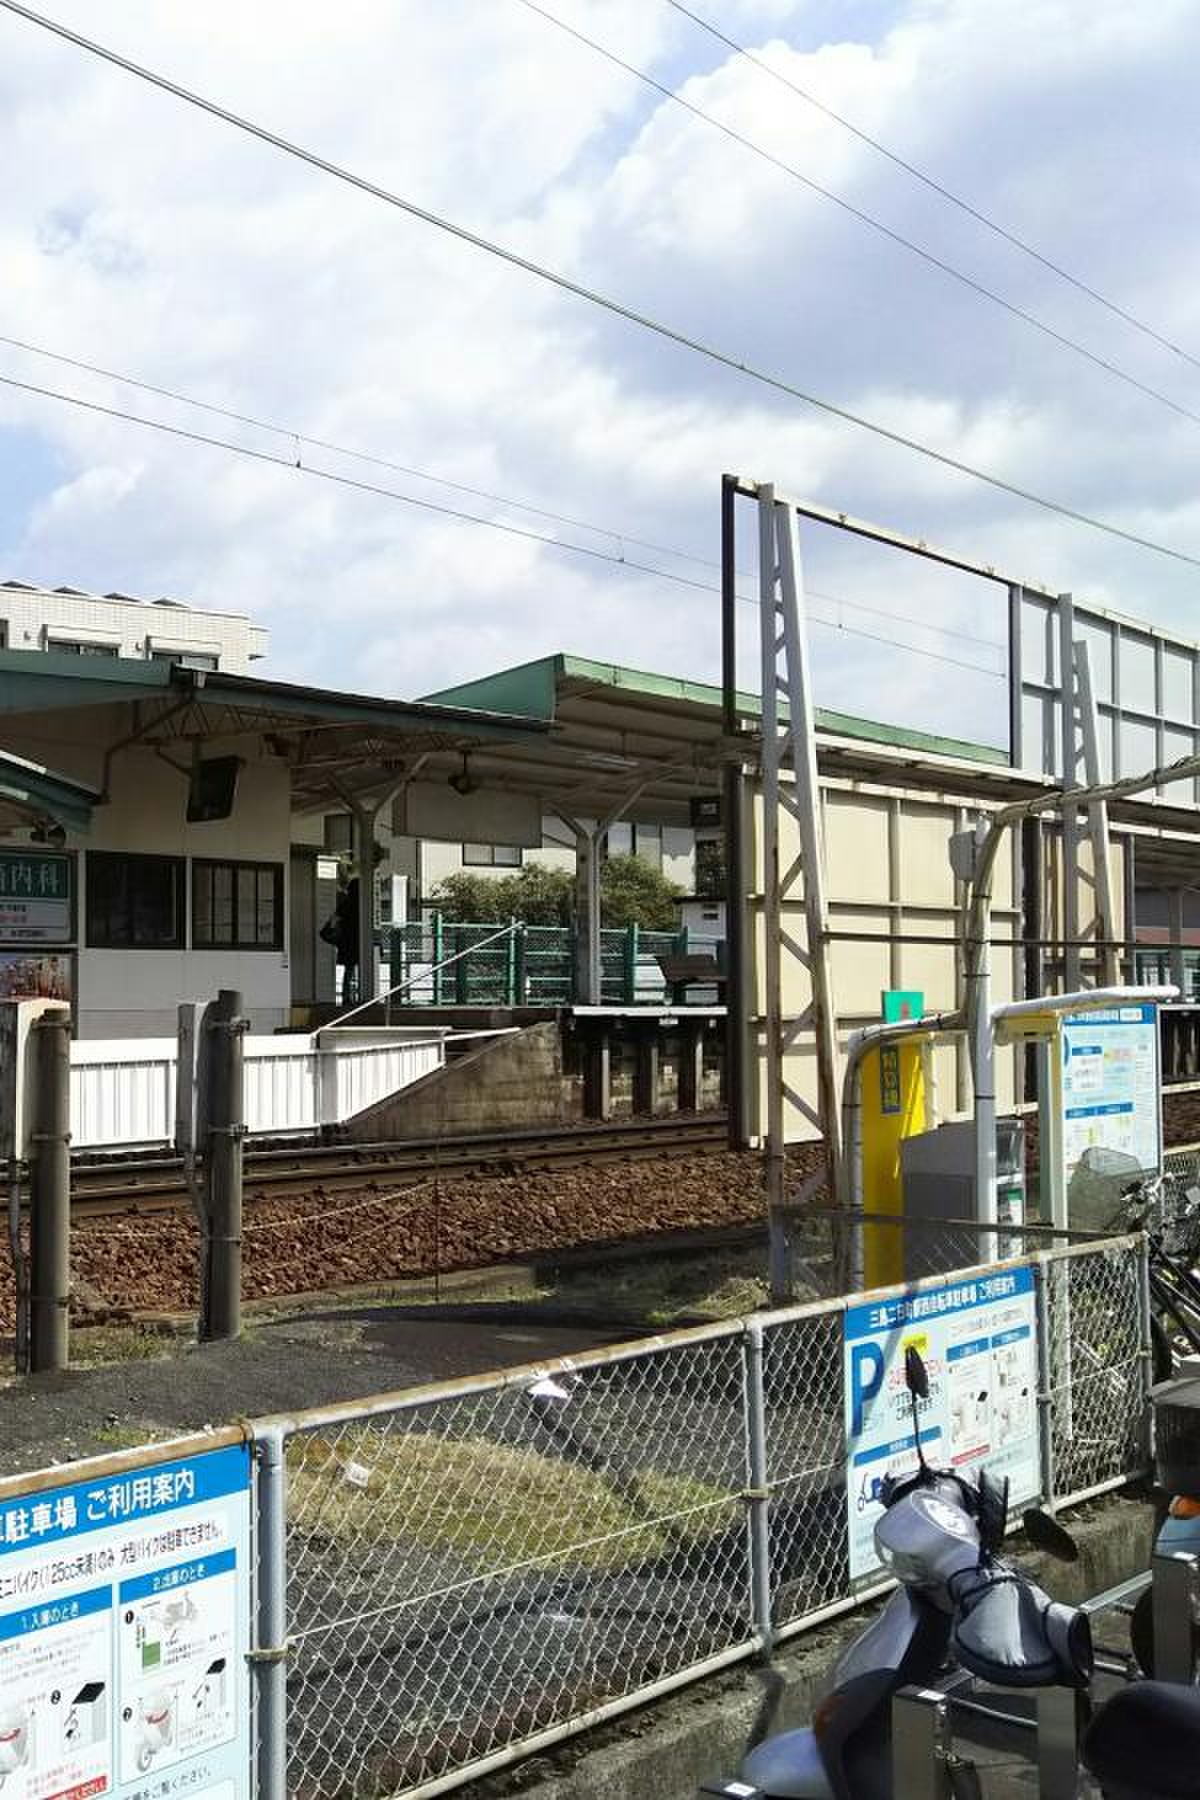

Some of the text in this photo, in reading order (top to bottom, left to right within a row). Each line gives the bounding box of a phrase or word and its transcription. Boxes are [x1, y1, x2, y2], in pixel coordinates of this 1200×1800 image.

[851, 1341, 885, 1438] P
[86, 1467, 196, 1521] ご利用案内
